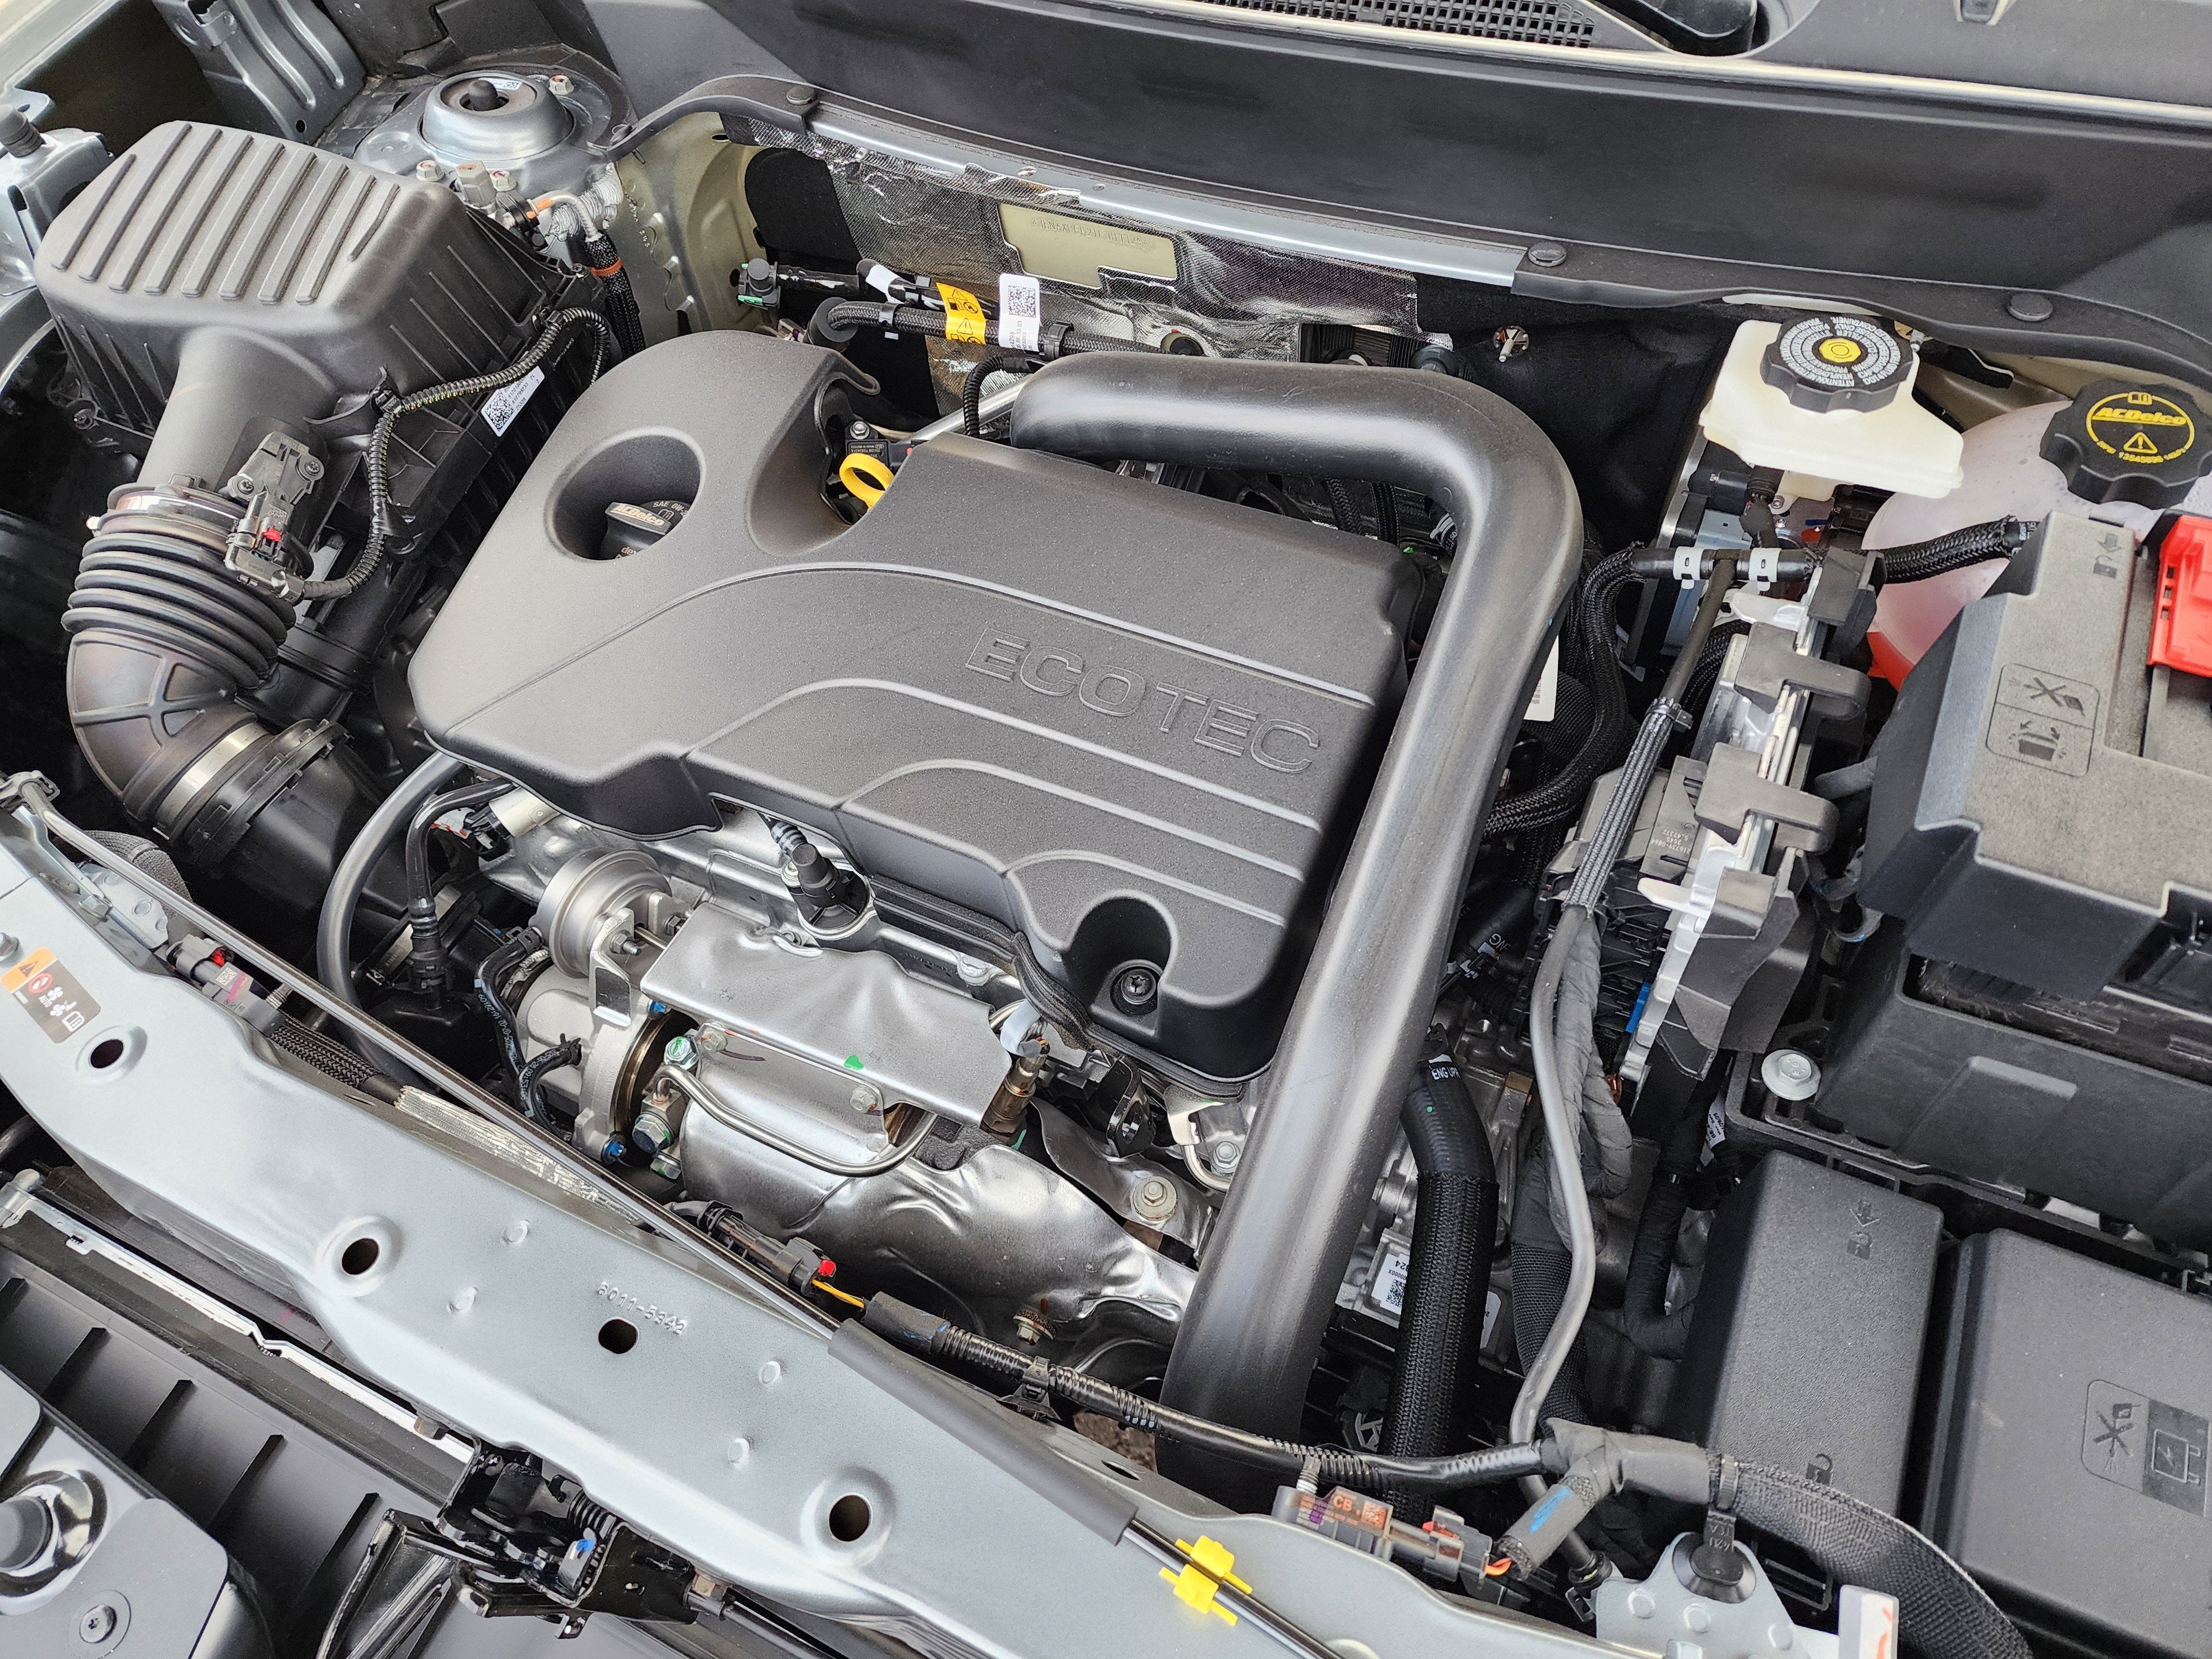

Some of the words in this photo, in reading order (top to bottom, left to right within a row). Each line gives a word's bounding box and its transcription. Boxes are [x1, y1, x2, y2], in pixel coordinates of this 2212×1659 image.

[1811, 325, 1826, 333] DOT
[1834, 324, 1855, 332] ONLY
[1853, 326, 1871, 336] USE
[1814, 375, 1857, 387] ATTENTION
[1861, 375, 1881, 385] DOT
[2091, 407, 2187, 425] ACDelco
[612, 504, 665, 526] ACDelco
[965, 627, 1320, 774] ECOTEC
[38, 995, 52, 1008] AUTO
[1431, 1067, 1449, 1080] ENG
